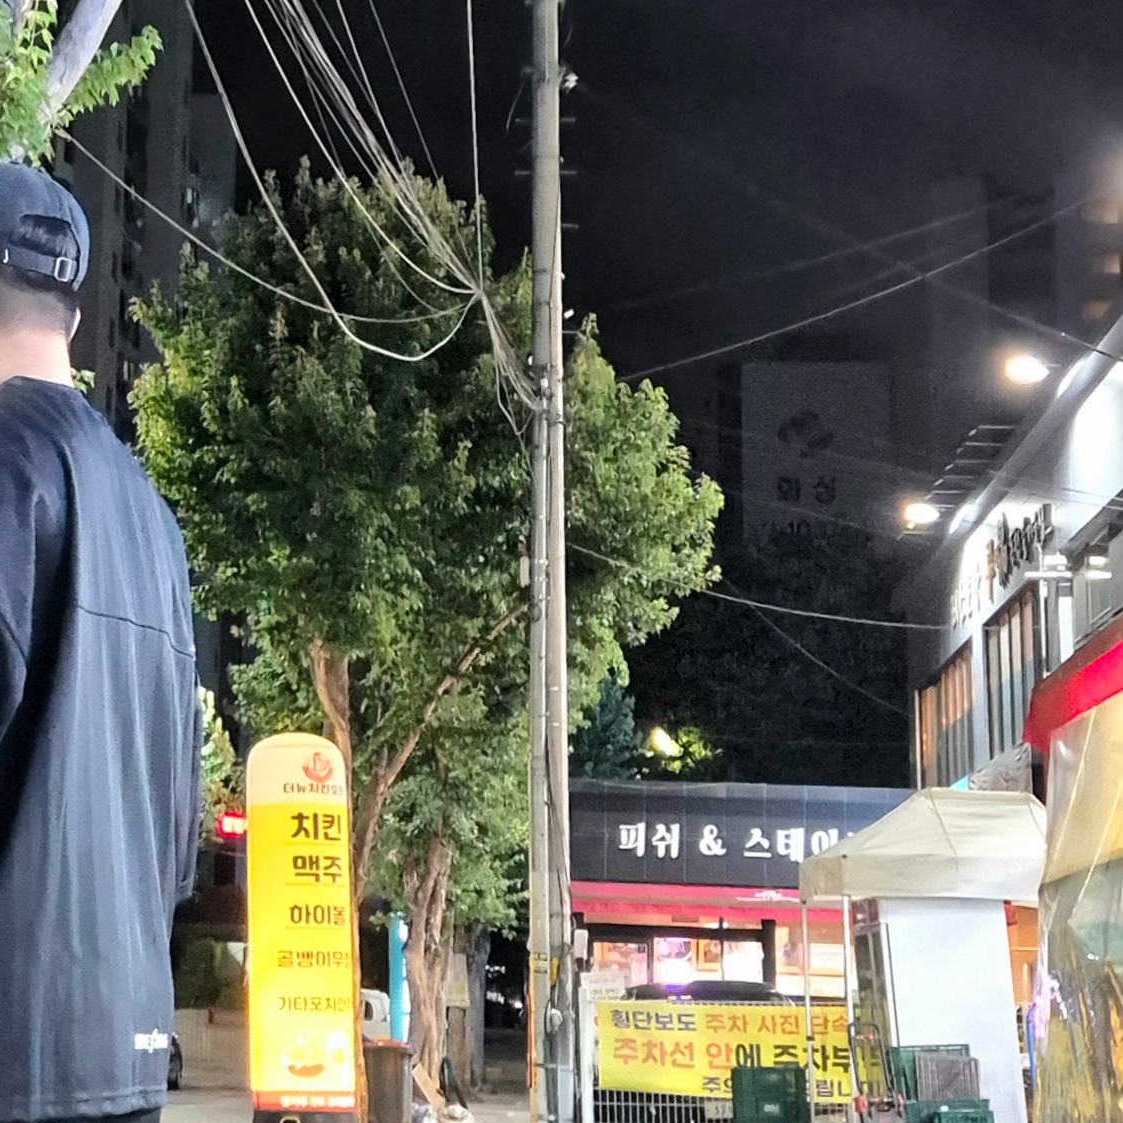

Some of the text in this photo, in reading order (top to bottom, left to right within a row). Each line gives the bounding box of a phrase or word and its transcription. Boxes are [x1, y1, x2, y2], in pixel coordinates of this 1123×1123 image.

[290, 811, 342, 842] 치킨
[618, 822, 854, 863] 피쉬 & 스테이
[292, 854, 343, 883] 맥주
[289, 904, 346, 927] 하이볼
[610, 1009, 697, 1032] 횡단보도
[705, 1013, 749, 1034] 주차
[757, 1014, 801, 1035] 사진
[613, 1037, 696, 1069] 주차선
[705, 1042, 762, 1070] 안에
